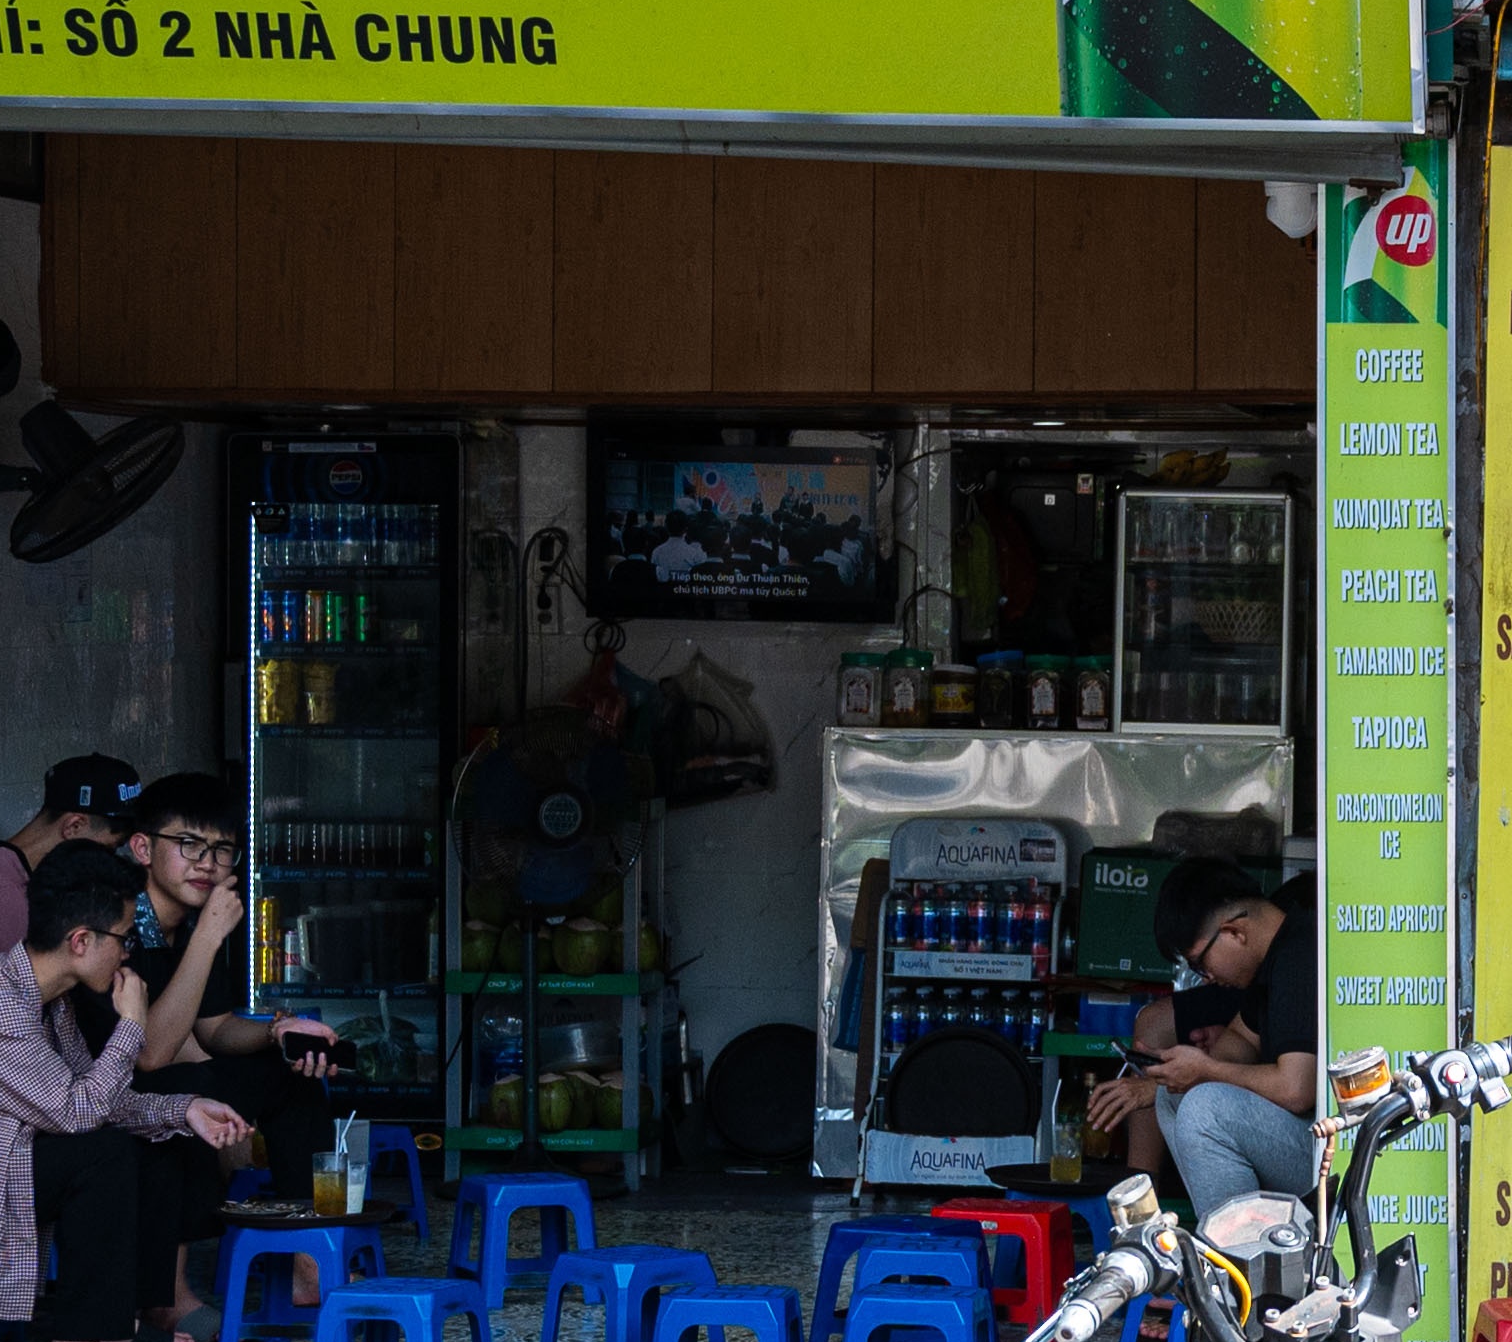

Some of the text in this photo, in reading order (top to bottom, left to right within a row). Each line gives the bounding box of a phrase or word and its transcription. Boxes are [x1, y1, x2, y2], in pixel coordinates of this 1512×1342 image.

[160, 10, 194, 59] 2
[216, 1, 340, 64] NHÀ
[354, 9, 558, 66] CHUNG
[1355, 349, 1424, 383] COFFEE
[1339, 423, 1439, 457] LEMON TEA
[1333, 498, 1445, 534] KUMQUAT TEA
[1341, 570, 1439, 604] PEACH TEA
[1334, 646, 1445, 677] TAMARIND ICE
[1352, 716, 1428, 750] TAPIOCA
[1336, 793, 1444, 824] DRACONTOMELON
[936, 843, 1018, 868] AQUAFINA
[1379, 830, 1401, 860] ICE
[1336, 905, 1446, 934] SALTED APRICOT
[1335, 976, 1446, 1007] SWEET APRICOT
[911, 1150, 986, 1172] AQUAFINA
[1402, 1194, 1448, 1224] JUICE
